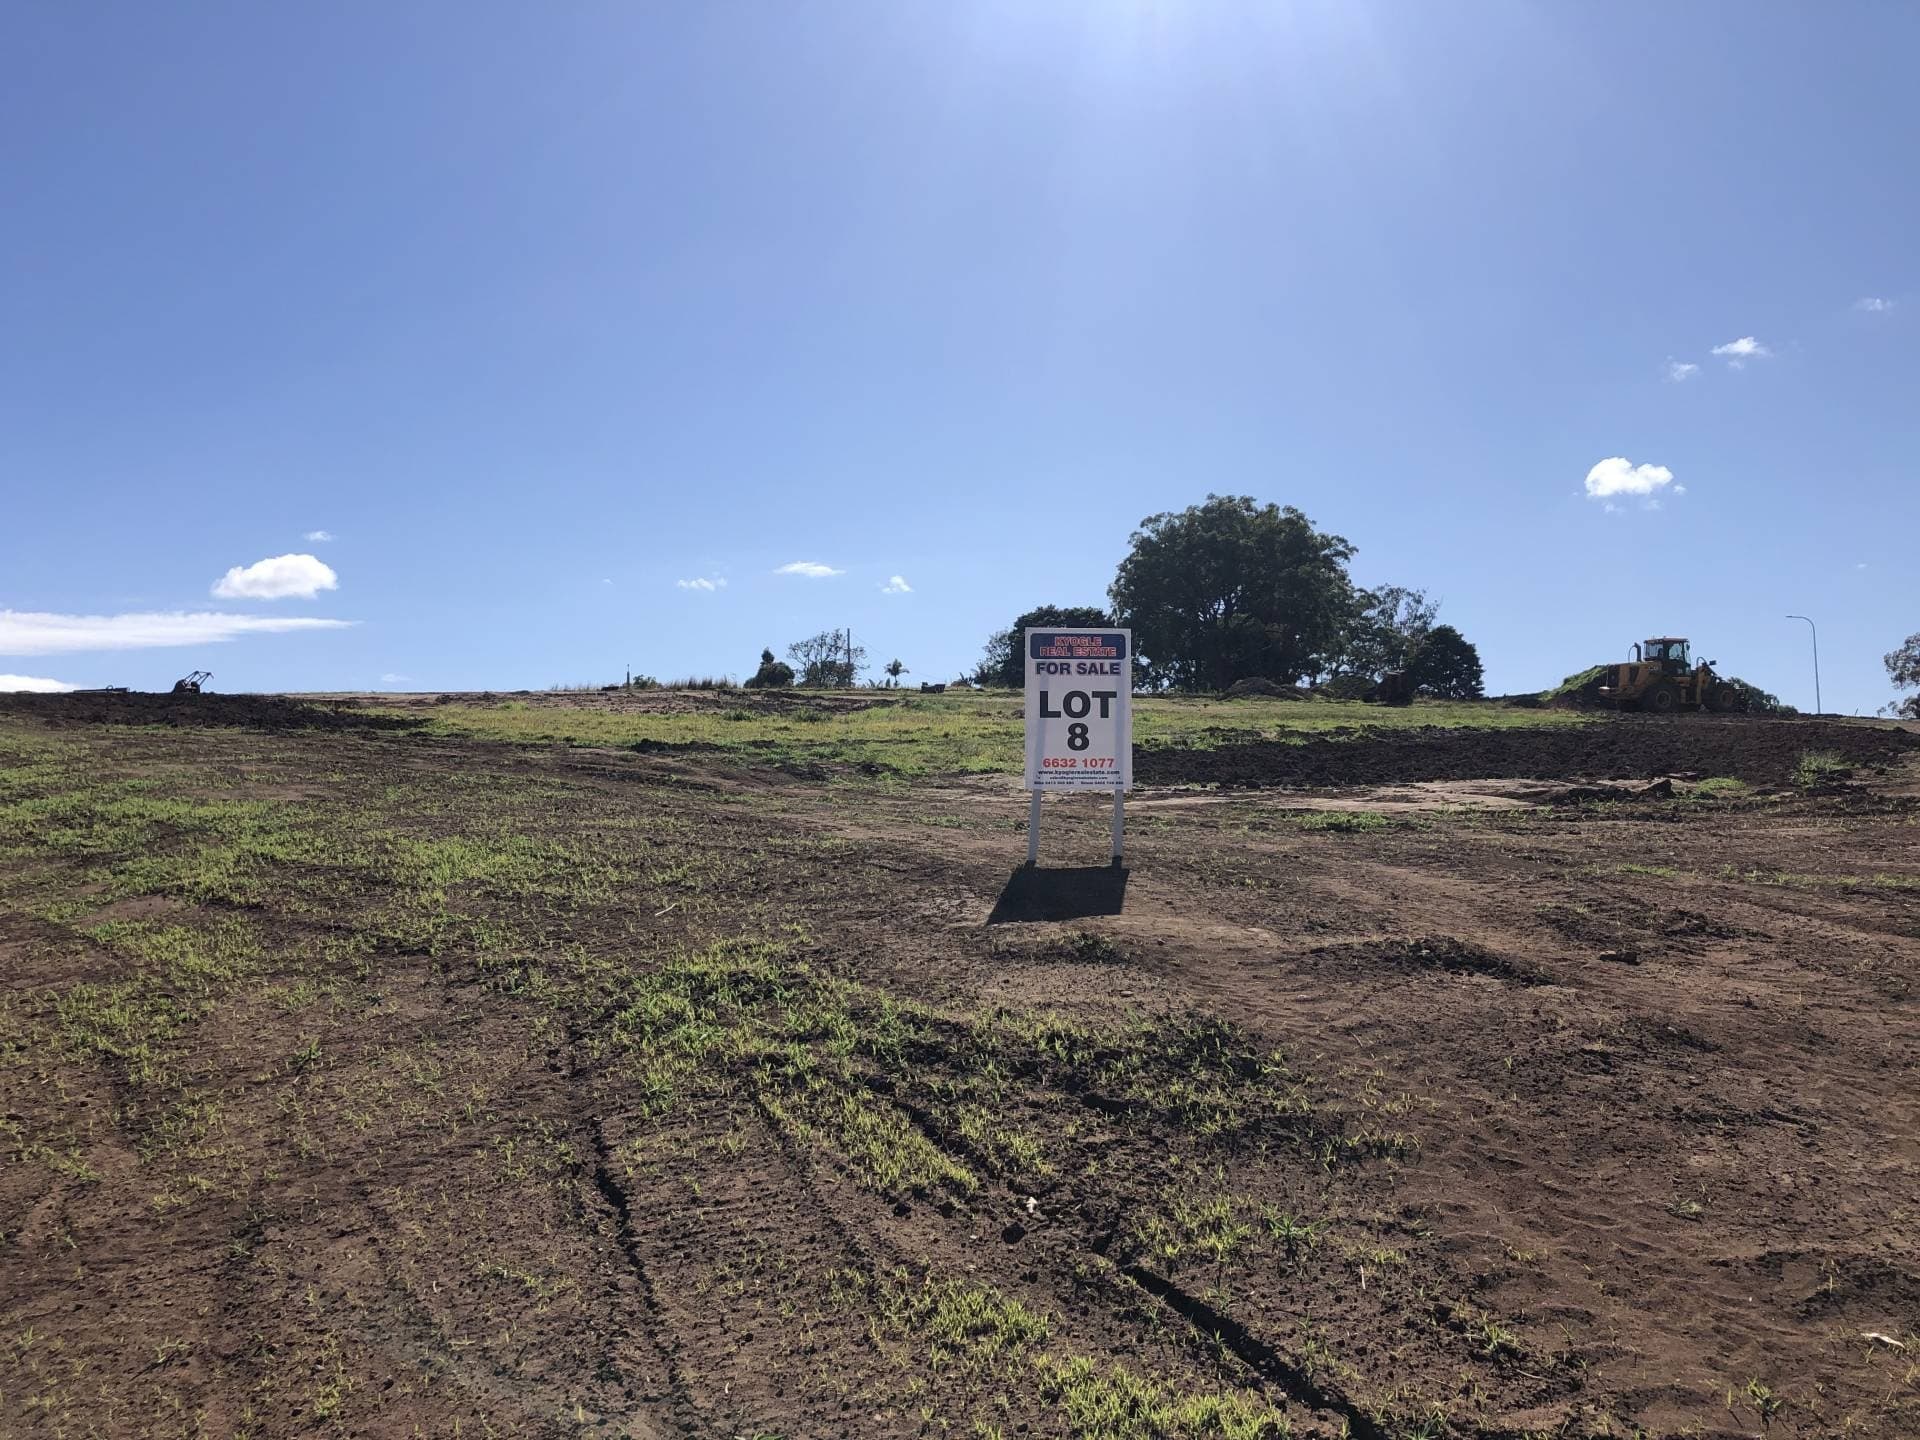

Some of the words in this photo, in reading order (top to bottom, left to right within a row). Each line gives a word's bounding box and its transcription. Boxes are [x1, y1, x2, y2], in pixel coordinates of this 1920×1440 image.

[1055, 637, 1102, 646] KYOGLE
[1040, 647, 1070, 656] REAL
[1073, 647, 1117, 656] ESTATE
[1036, 662, 1071, 675] FOR
[1076, 662, 1121, 675] SALE
[1039, 691, 1117, 718] LOT
[1067, 723, 1090, 751] 8
[1043, 758, 1077, 768] 6632
[1082, 758, 1115, 768] 1077
